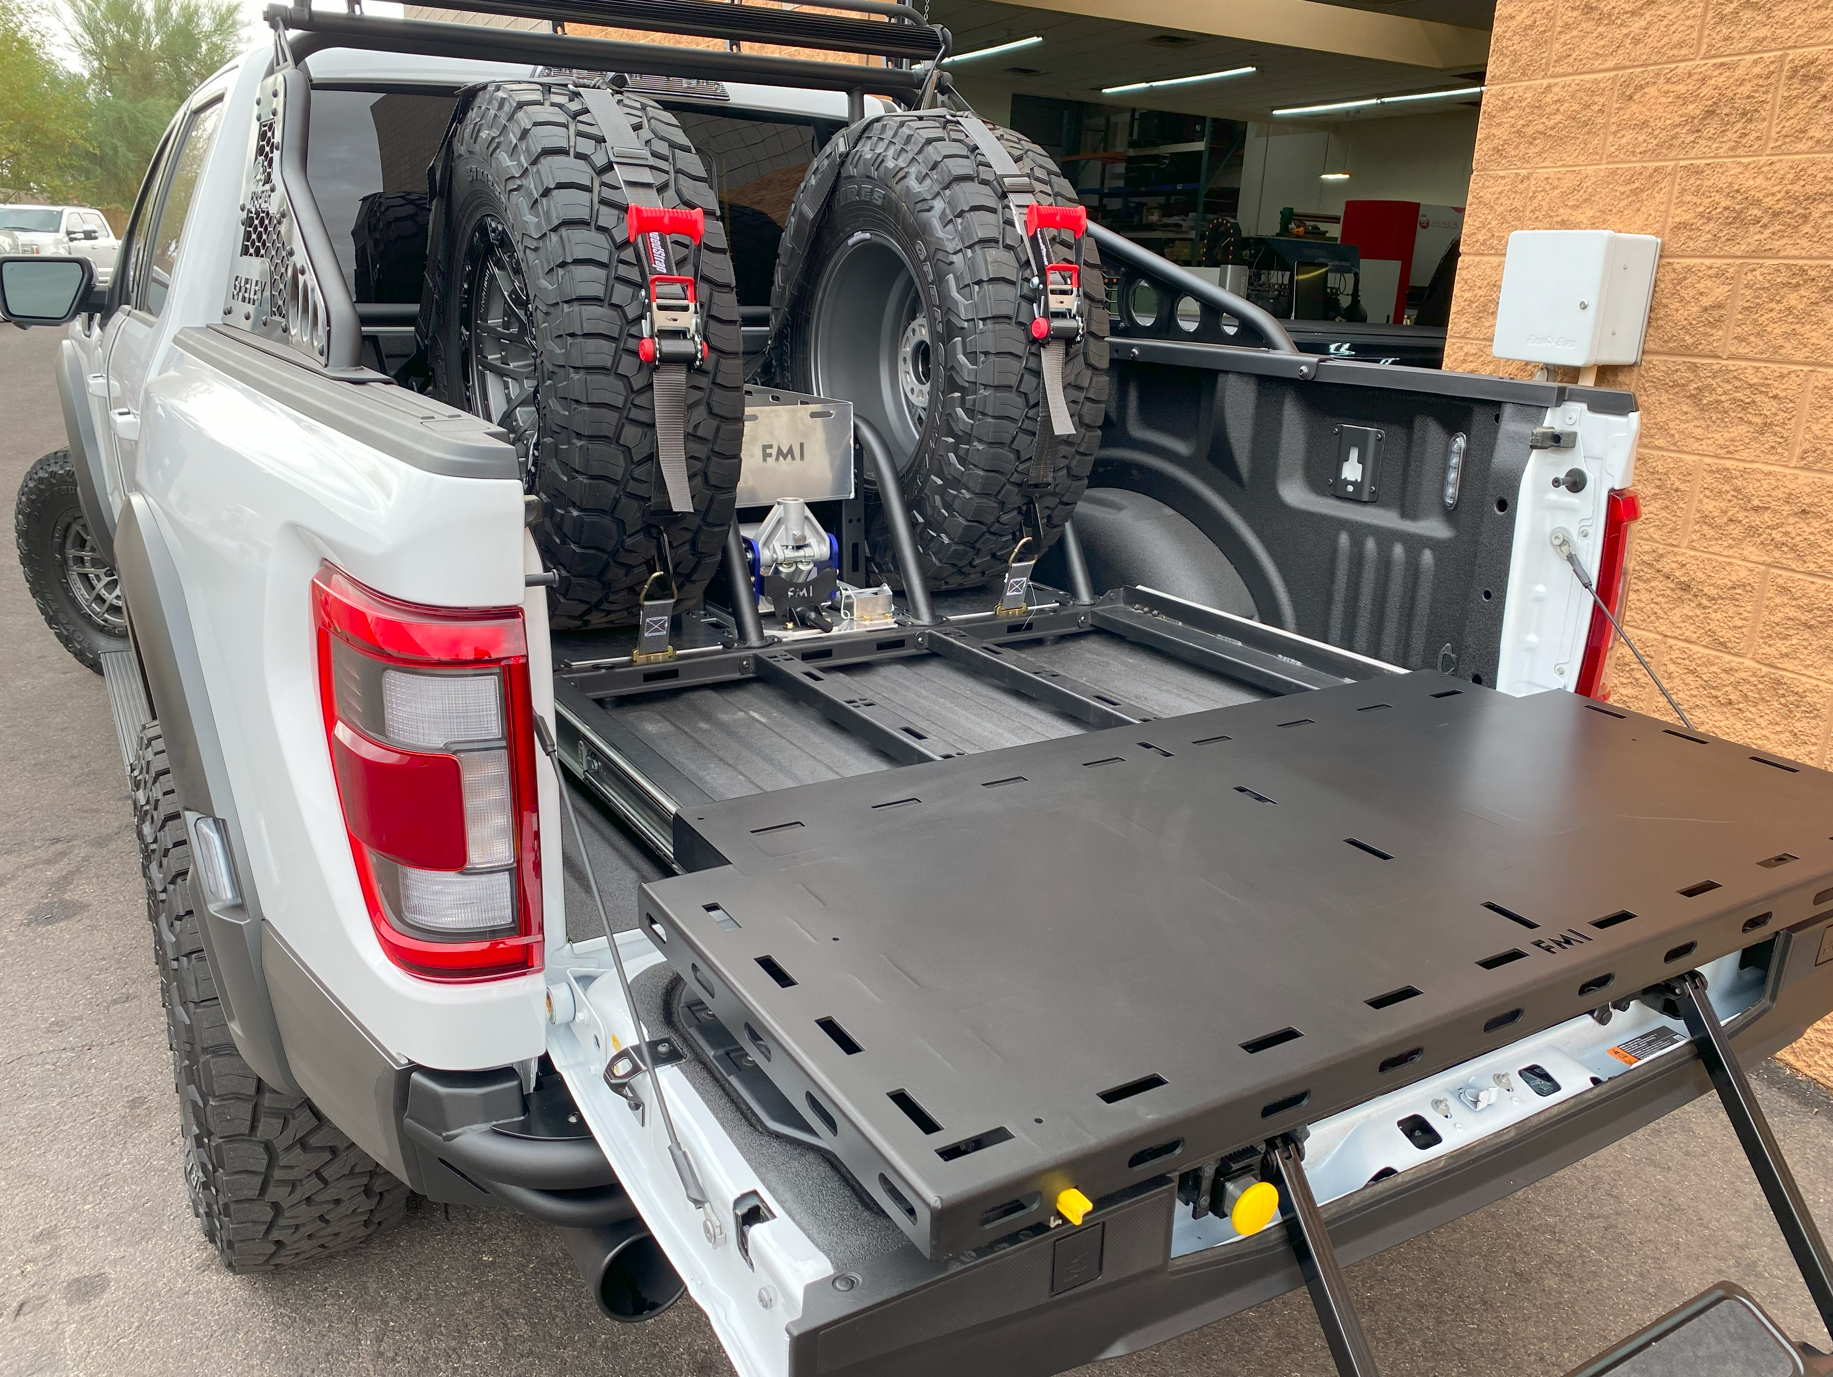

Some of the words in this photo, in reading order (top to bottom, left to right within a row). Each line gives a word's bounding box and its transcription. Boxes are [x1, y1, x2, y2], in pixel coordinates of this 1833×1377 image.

[761, 442, 805, 463] FMI
[787, 585, 813, 598] FMI
[1530, 928, 1593, 954] FMI
